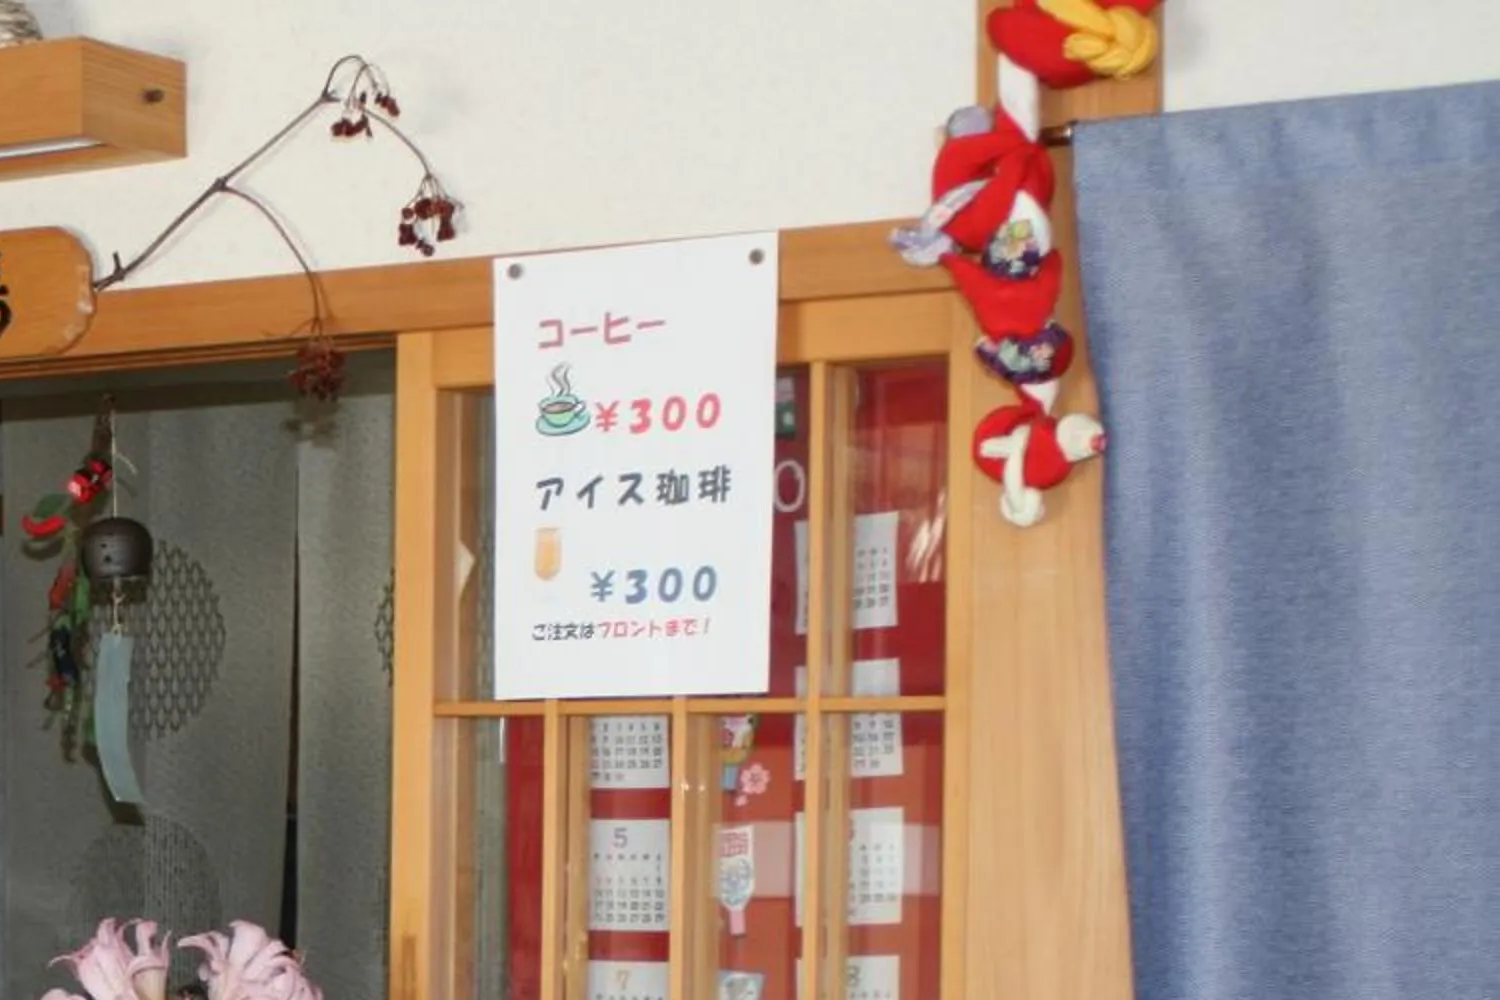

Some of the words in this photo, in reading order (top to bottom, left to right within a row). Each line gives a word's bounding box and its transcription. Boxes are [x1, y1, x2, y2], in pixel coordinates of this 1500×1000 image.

[537, 312, 666, 350] コーヒー
[595, 392, 722, 435] ¥300
[535, 465, 731, 511] アイス珈琲
[589, 566, 718, 605] ¥300
[612, 827, 629, 849] 5
